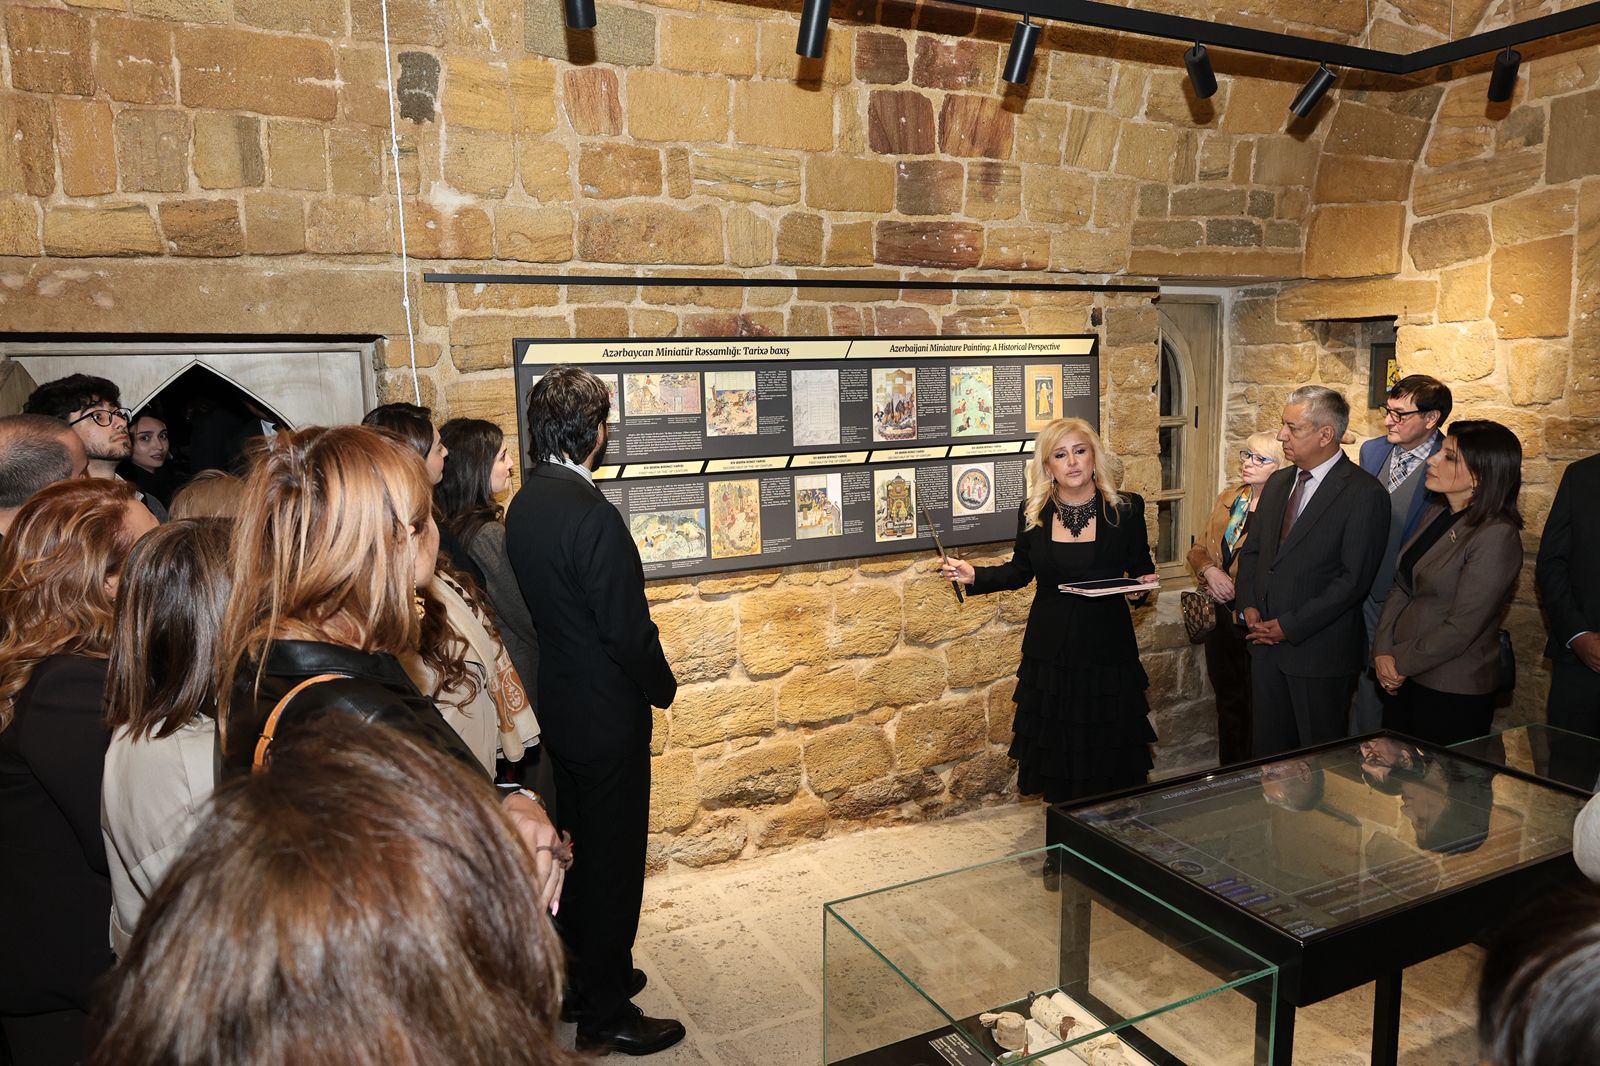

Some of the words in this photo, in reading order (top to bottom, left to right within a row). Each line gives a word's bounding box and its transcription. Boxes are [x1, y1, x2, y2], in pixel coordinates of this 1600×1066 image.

[602, 348, 654, 359] Azərbaycan
[656, 347, 694, 357] Miniatür
[695, 346, 741, 358] Rəssamlığı:
[743, 346, 769, 356] Tarixə
[770, 346, 790, 357] baxış
[889, 344, 929, 355] Azerbaijani
[929, 343, 963, 352] Miniature
[963, 343, 991, 354] Painting:
[992, 343, 998, 351] A
[998, 342, 1027, 351] Historical
[1027, 342, 1061, 352] Perspective
